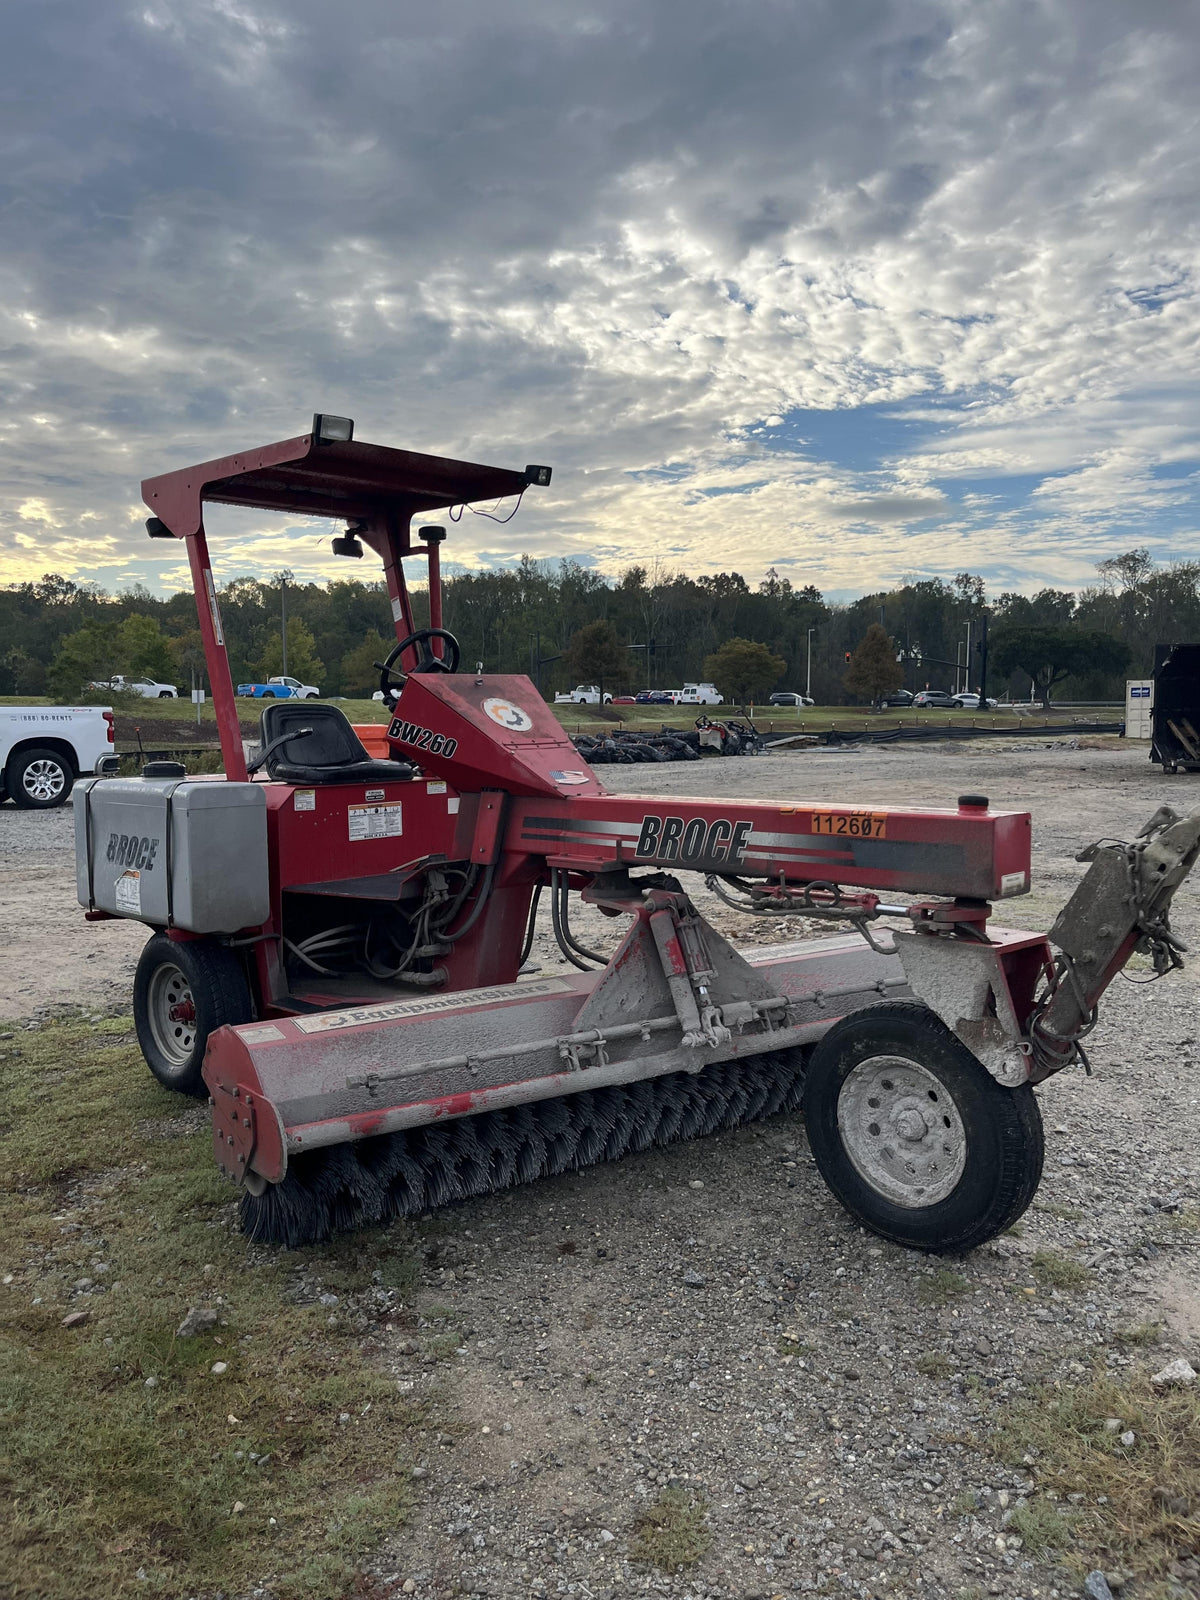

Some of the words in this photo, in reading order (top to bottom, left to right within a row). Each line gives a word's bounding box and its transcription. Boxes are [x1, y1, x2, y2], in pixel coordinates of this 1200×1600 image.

[387, 717, 458, 759] BW260
[635, 815, 753, 865] BROCE
[813, 815, 885, 837] 112607
[107, 833, 159, 871] BROCE
[351, 983, 550, 1022] EquipmentShare
